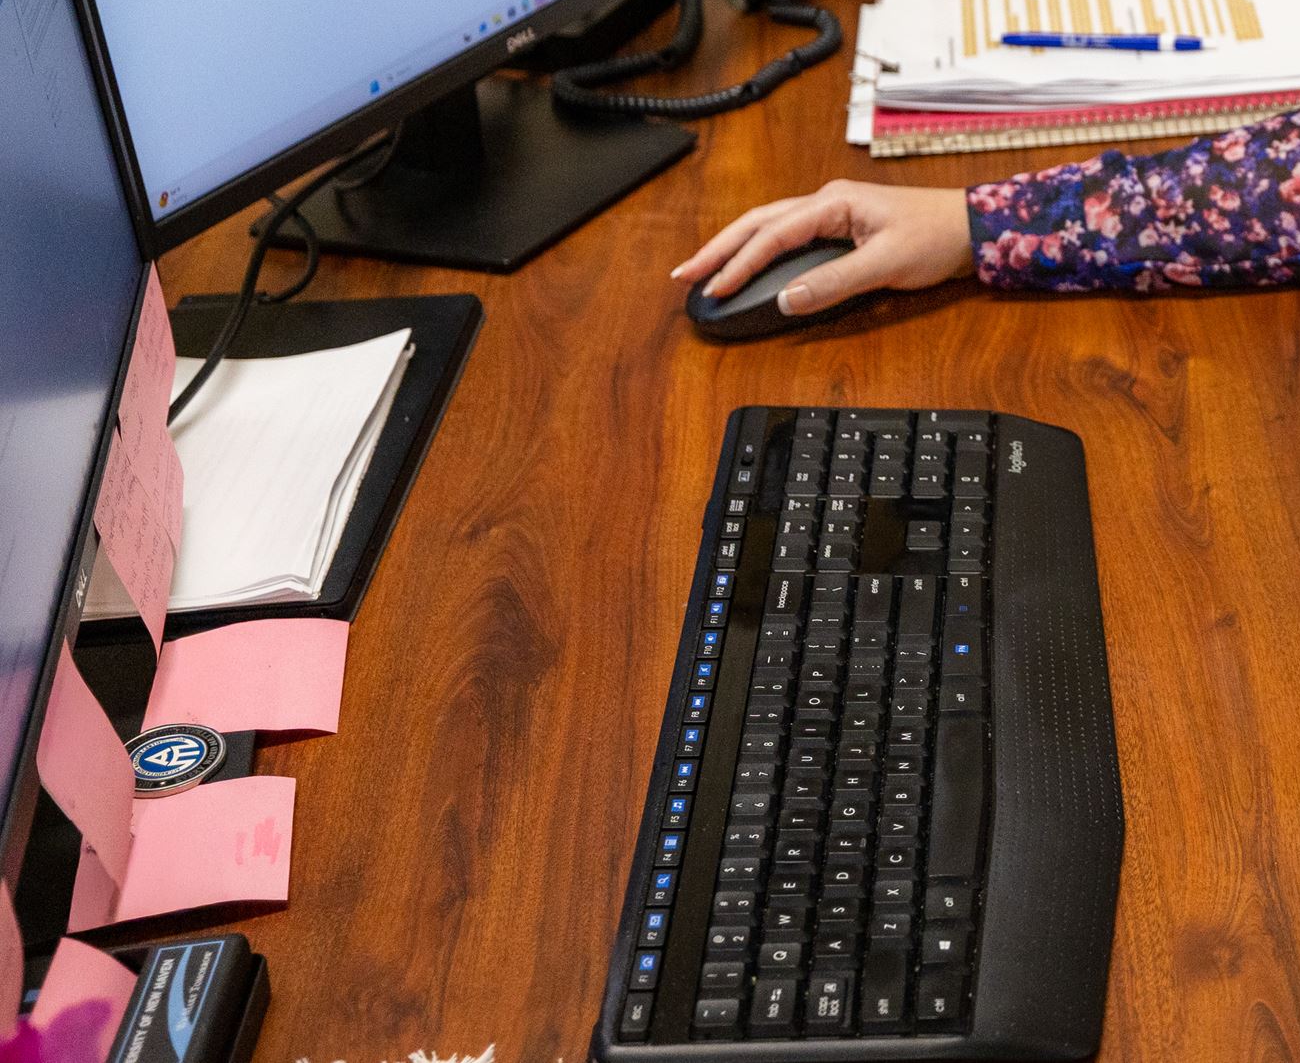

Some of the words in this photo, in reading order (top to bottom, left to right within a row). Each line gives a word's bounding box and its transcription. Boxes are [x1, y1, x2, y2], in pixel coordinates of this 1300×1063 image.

[506, 26, 535, 53] DELL
[1008, 440, 1027, 474] logitech
[777, 580, 789, 609] backspace
[871, 578, 880, 594] enter
[153, 958, 175, 990] HAVEN
[144, 991, 162, 1013] NEW
[767, 1002, 779, 1018] tab
[818, 996, 829, 1017] caps
[829, 998, 840, 1017] lock
[877, 998, 889, 1015] shift
[934, 997, 945, 1013] ctrl
[139, 1015, 153, 1027] OF
[124, 1030, 148, 1063] ERSITY
